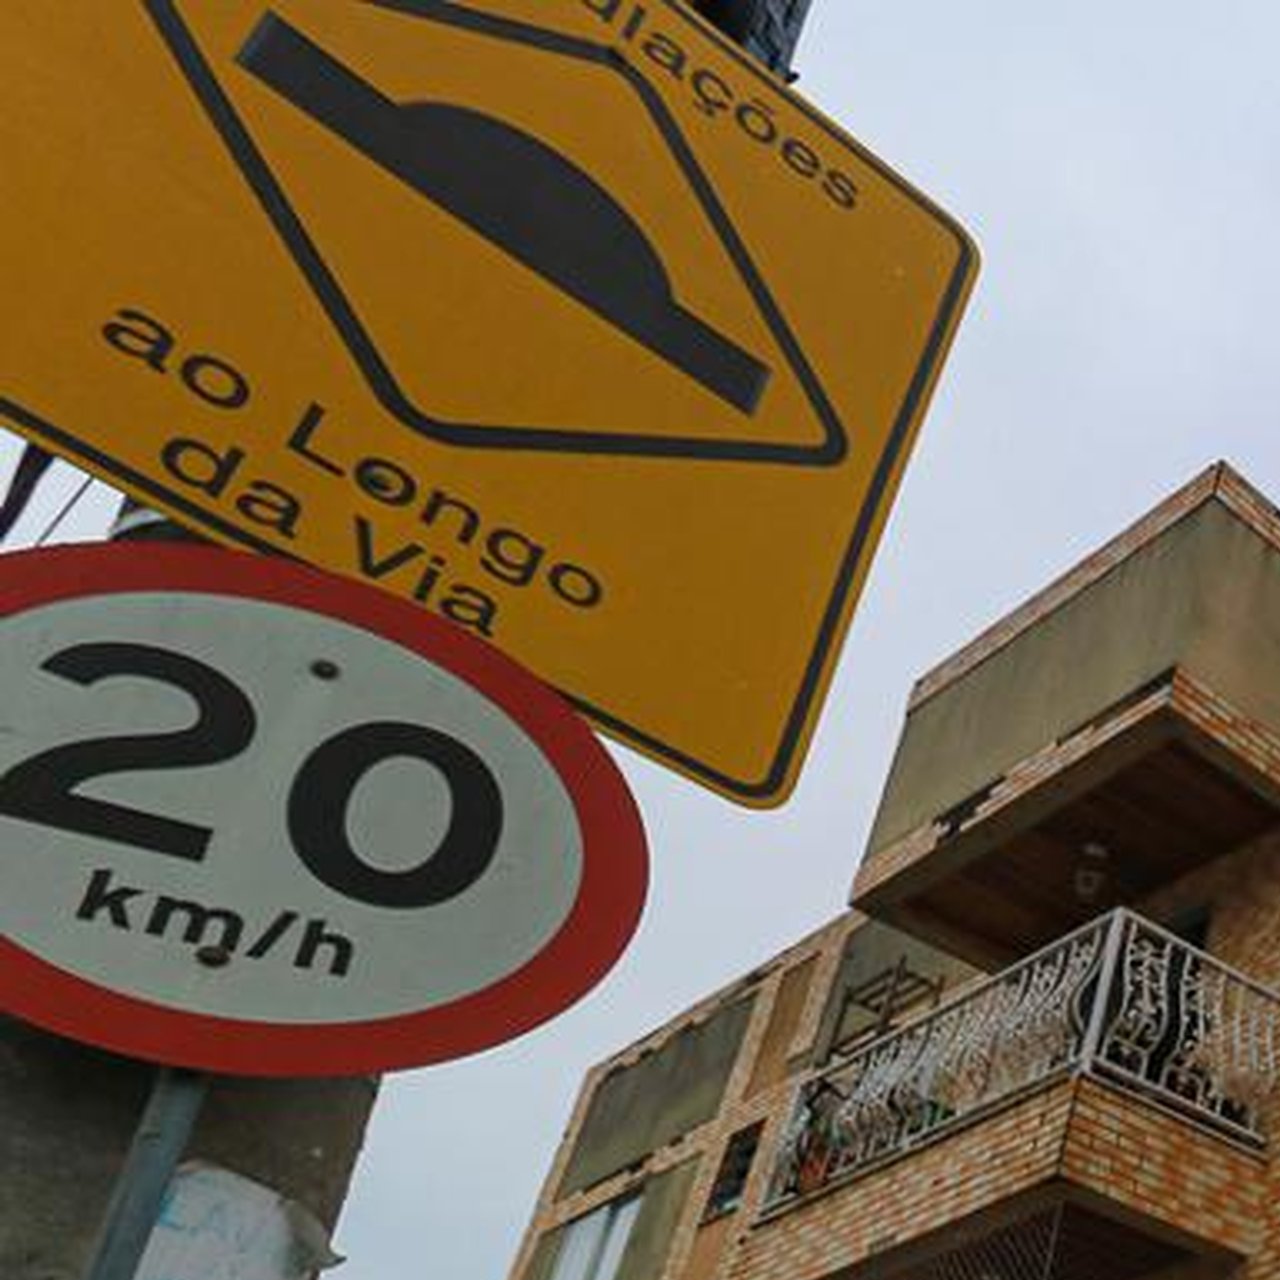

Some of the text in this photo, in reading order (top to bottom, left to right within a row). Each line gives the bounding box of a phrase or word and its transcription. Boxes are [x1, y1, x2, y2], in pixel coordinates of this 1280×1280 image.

[103, 310, 602, 607] ao Longo
[161, 438, 497, 637] da Via
[0, 642, 503, 909] 20
[76, 870, 356, 976] km/h
